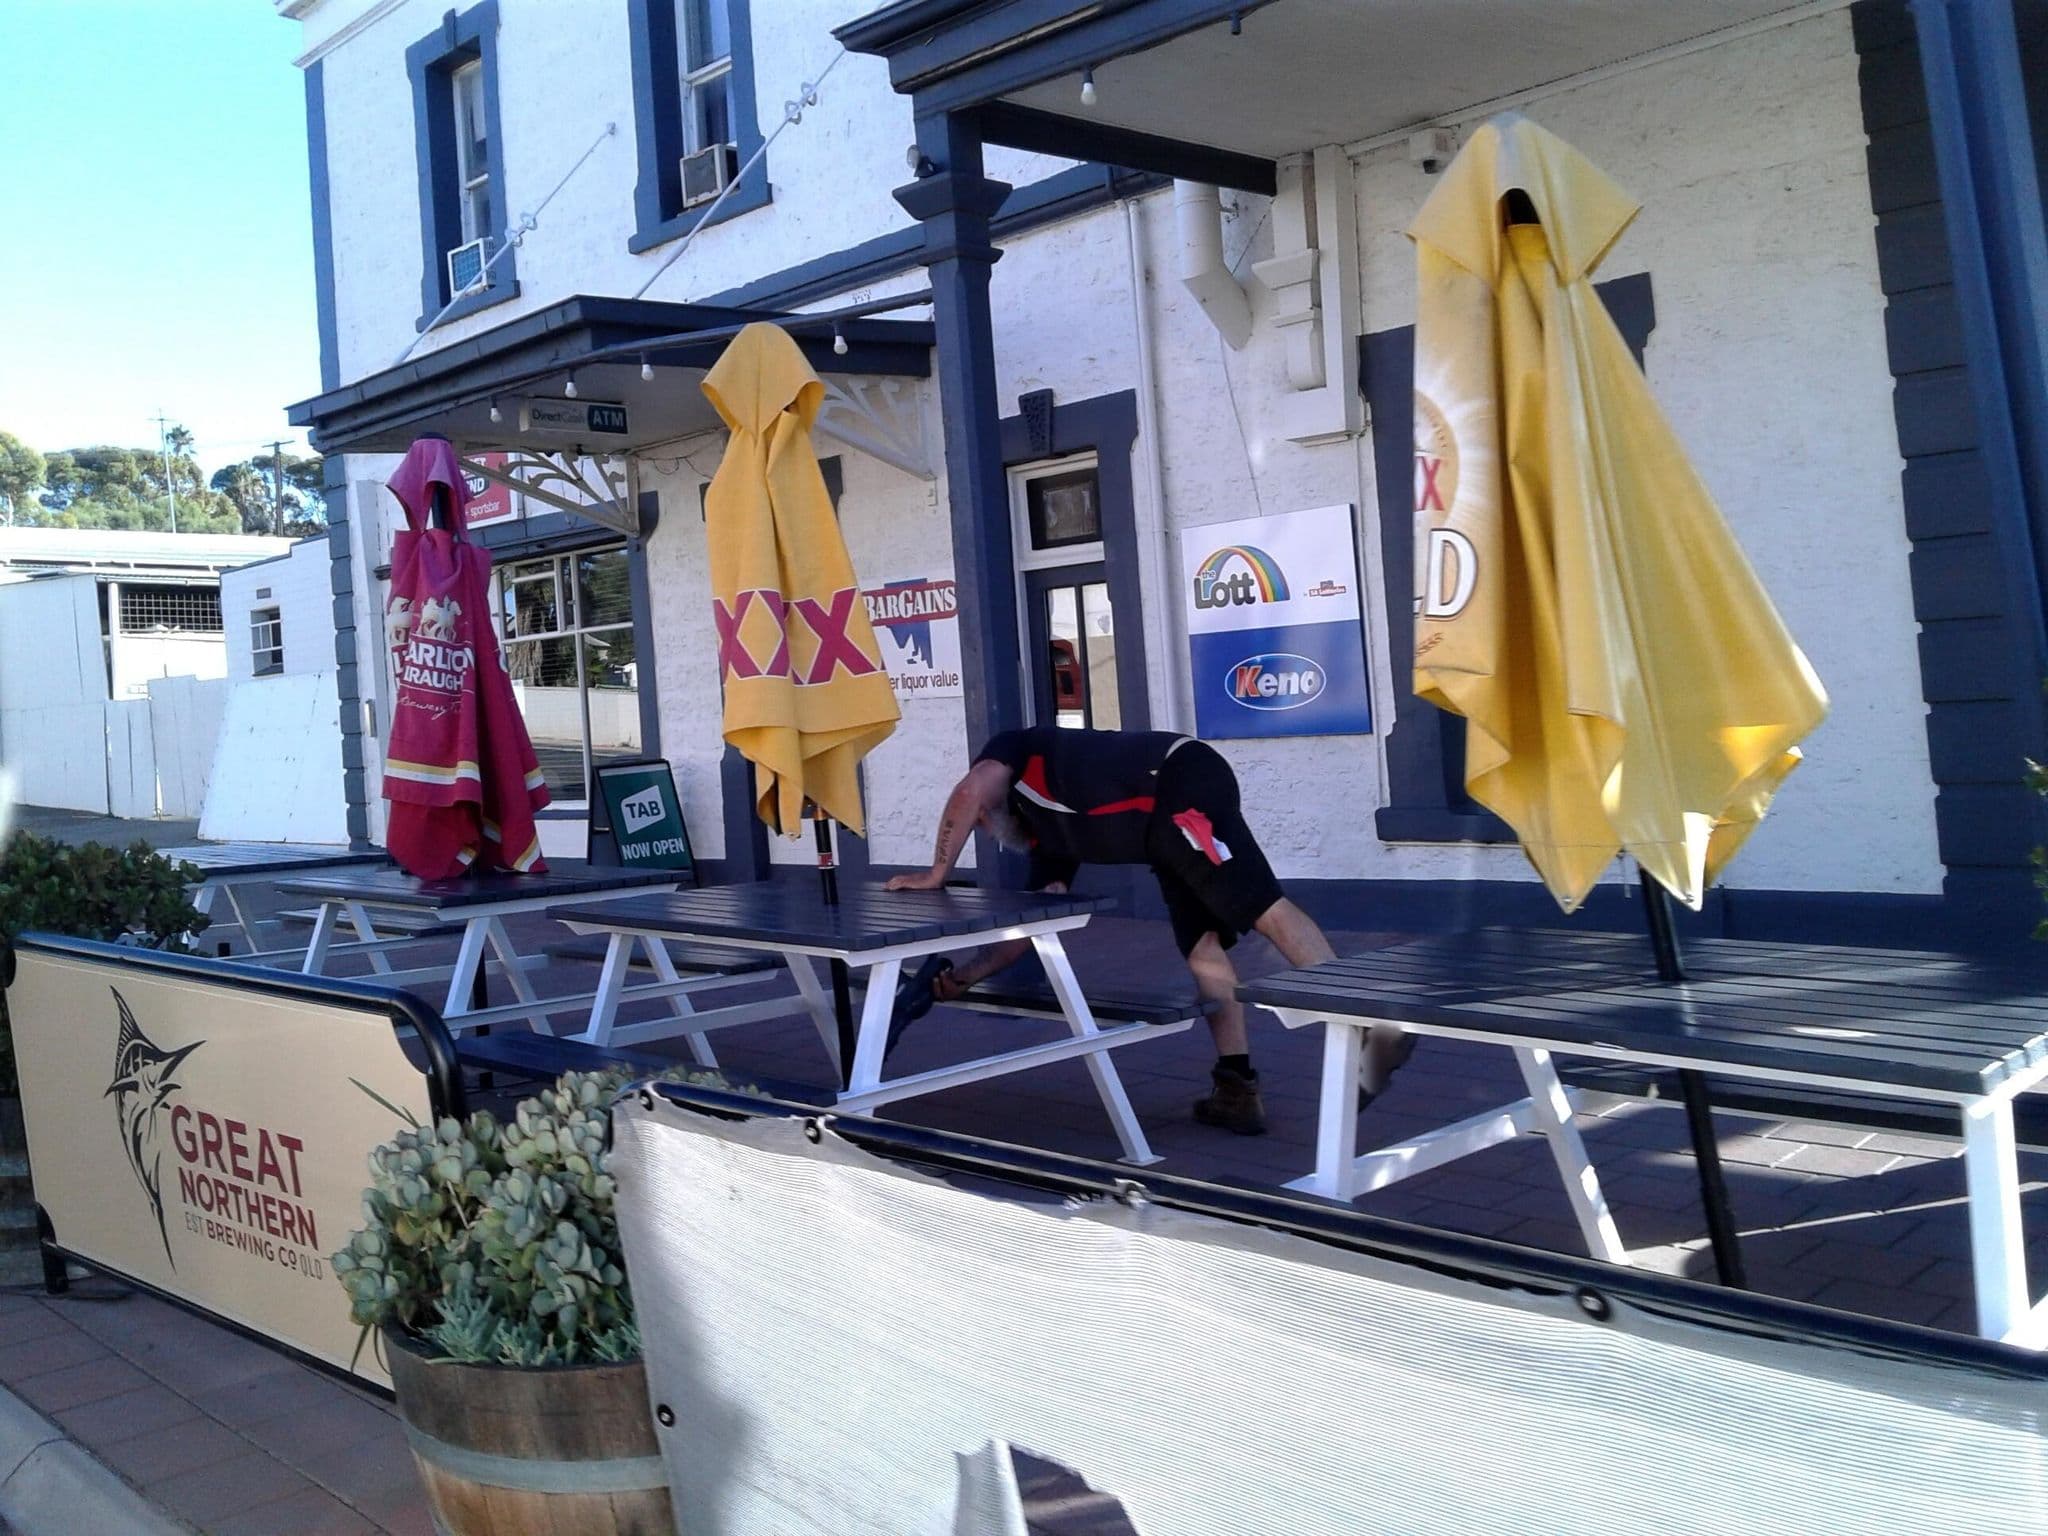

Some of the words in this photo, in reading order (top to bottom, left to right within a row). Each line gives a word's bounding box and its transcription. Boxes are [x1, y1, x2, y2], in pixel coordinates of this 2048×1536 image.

[592, 409, 624, 427] ATM
[864, 586, 957, 622] BARGAINS
[1194, 572, 1256, 609] Lott
[901, 673, 929, 695] liquor
[929, 671, 959, 688] value
[1235, 666, 1320, 697] Keno
[625, 800, 661, 819] TAB
[622, 842, 650, 860] NOW
[652, 837, 684, 856] OPEN
[171, 1105, 303, 1198] GREAT
[178, 1167, 318, 1251] NORTHERN
[206, 1219, 275, 1262] BREWING
